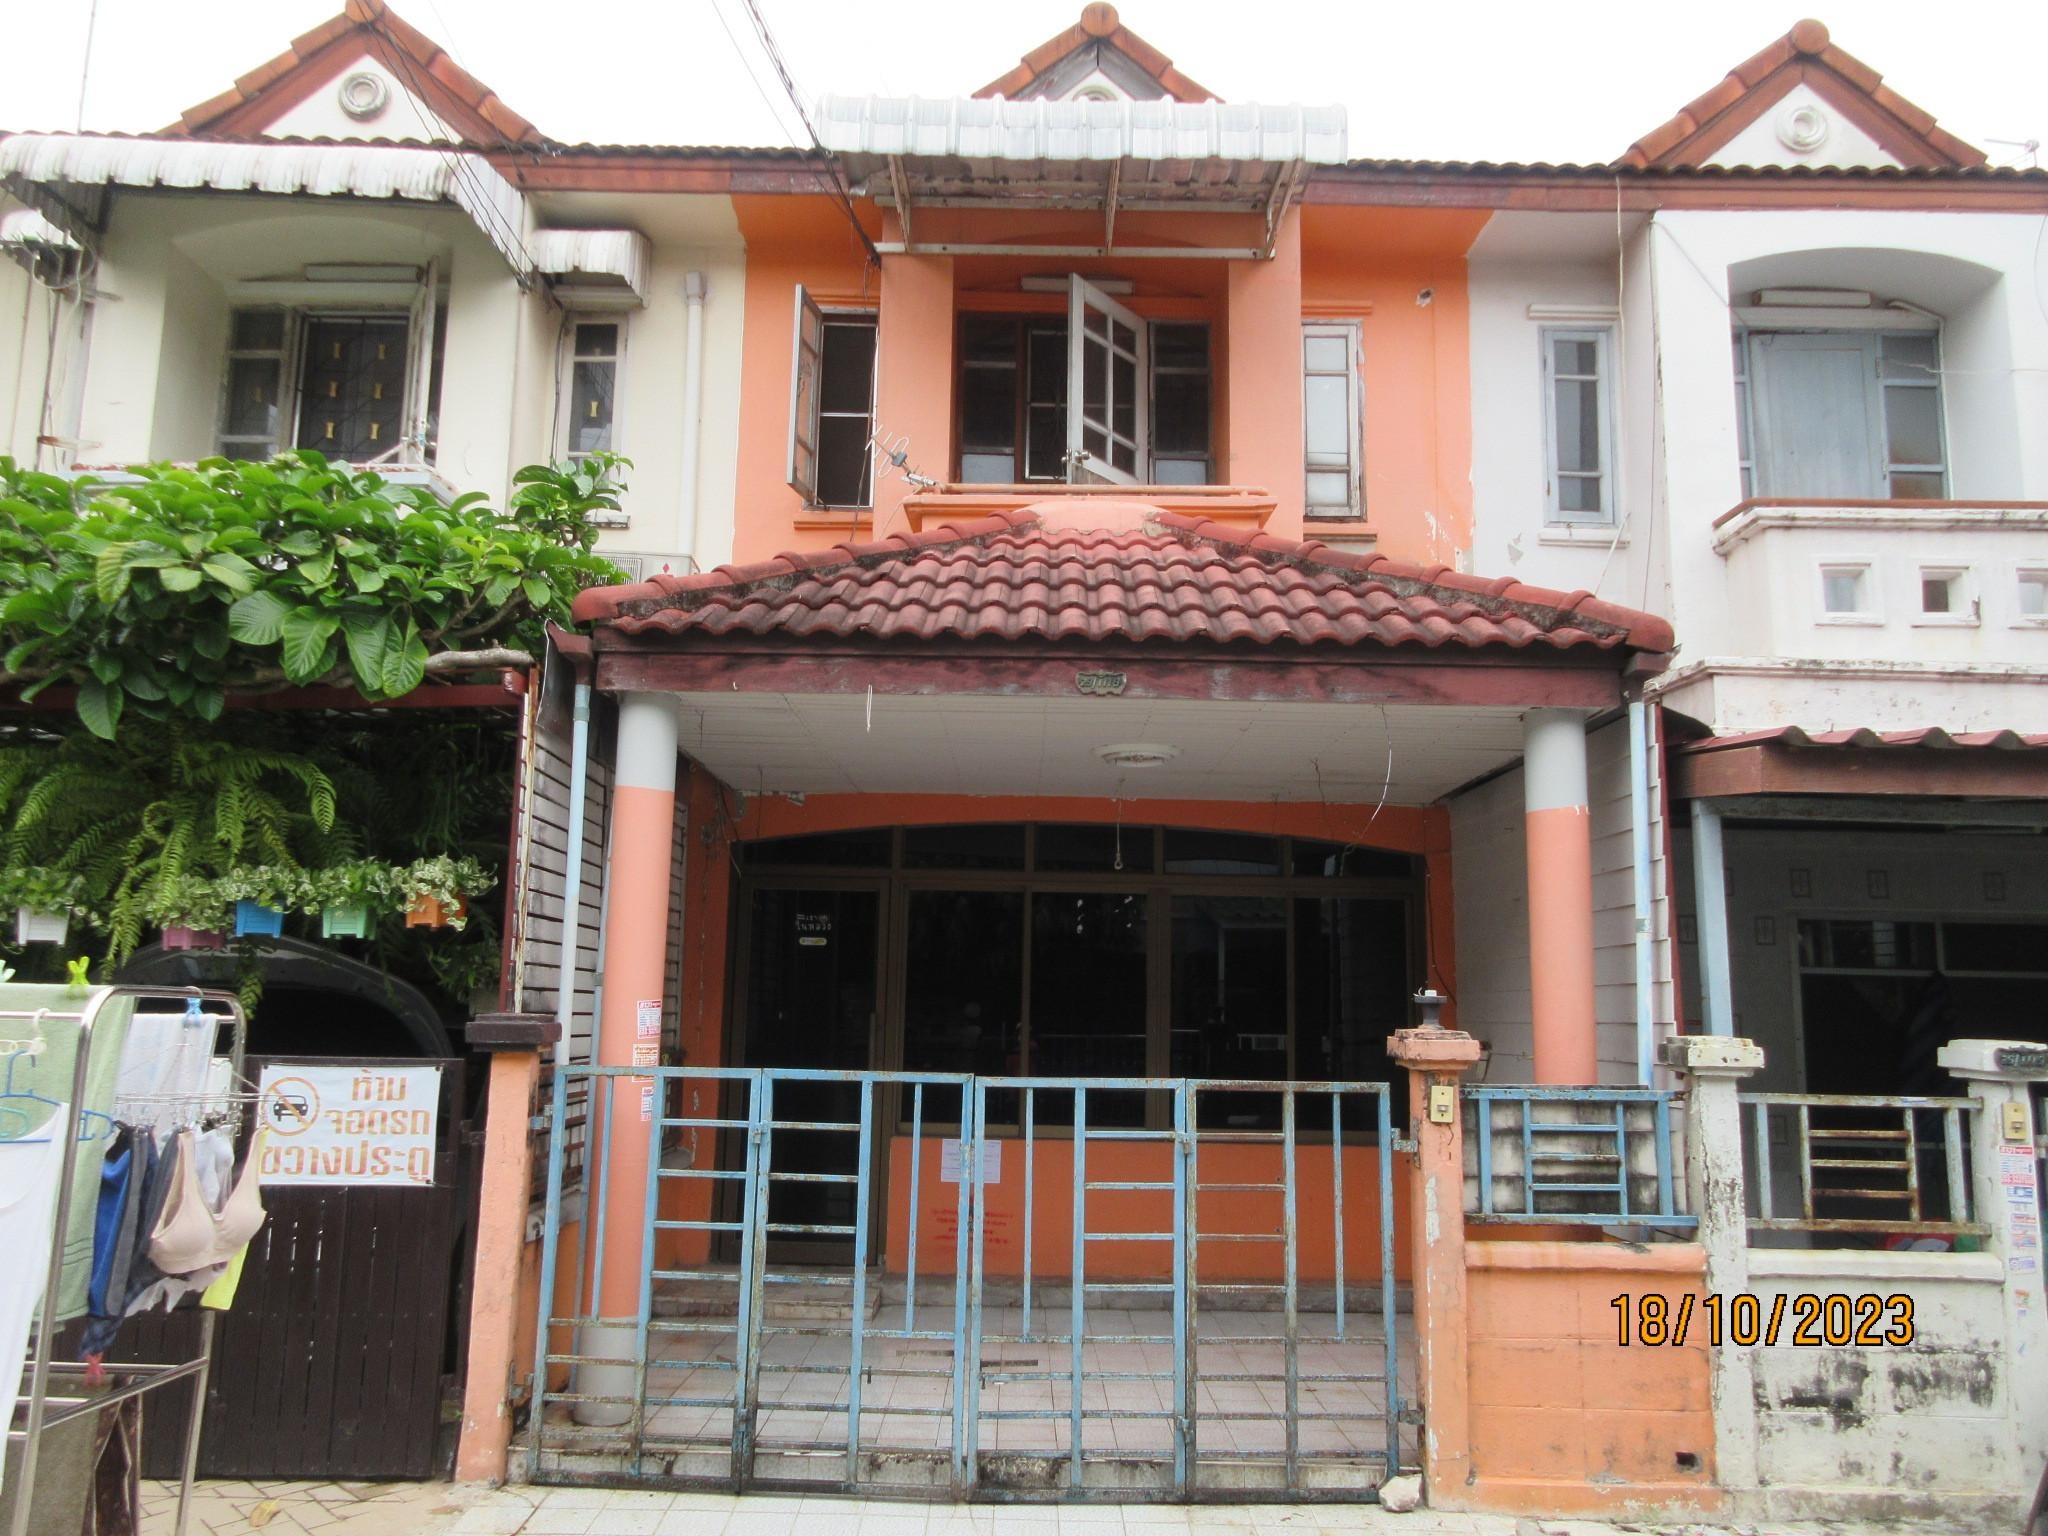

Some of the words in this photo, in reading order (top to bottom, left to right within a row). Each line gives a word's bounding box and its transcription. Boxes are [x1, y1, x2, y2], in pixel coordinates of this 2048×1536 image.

[351, 1069, 408, 1101] ห้าม
[324, 1109, 431, 1135] จอดรถ
[260, 1140, 431, 1182] ขวางประตู
